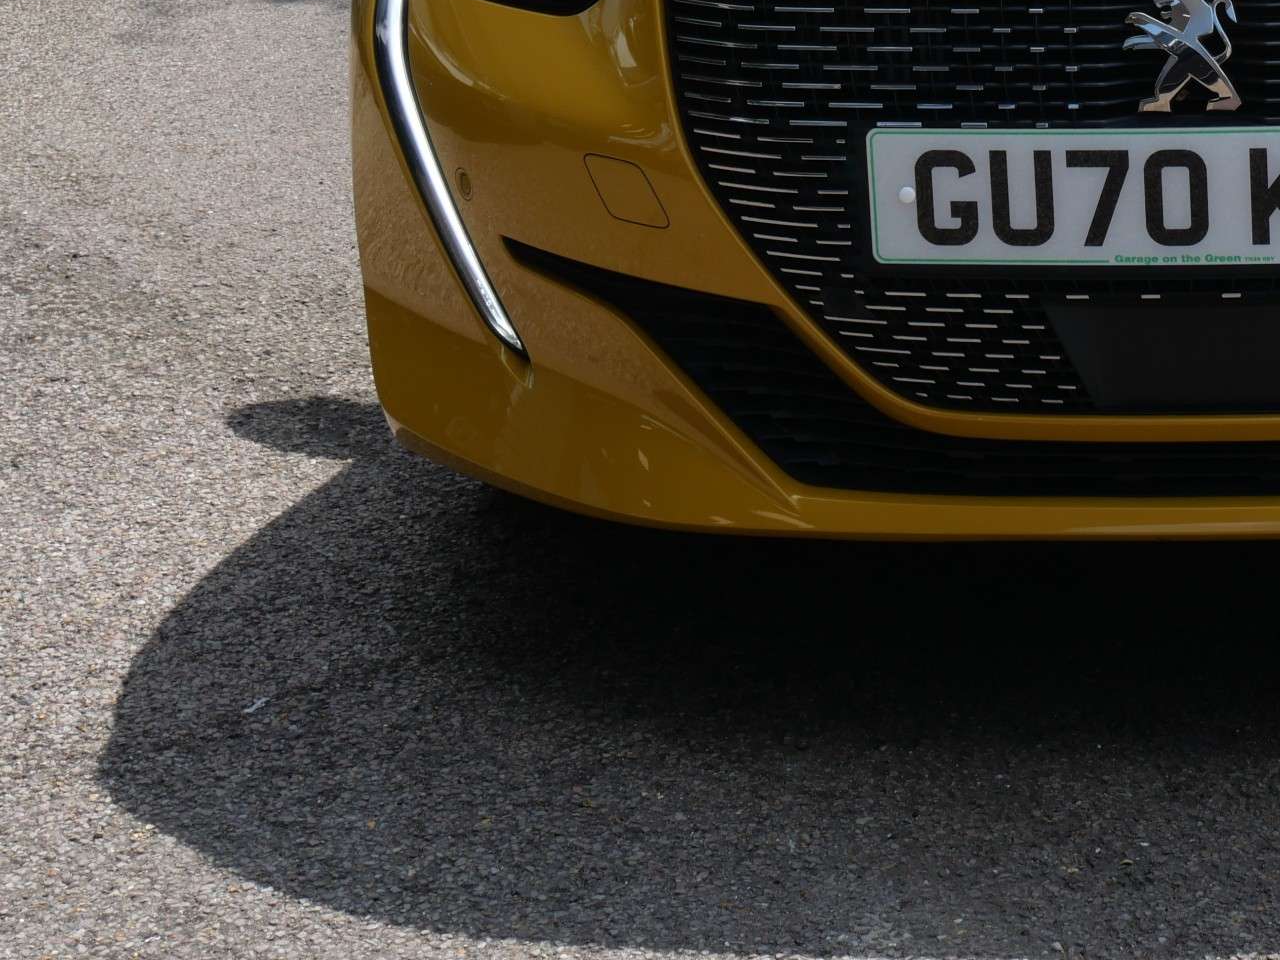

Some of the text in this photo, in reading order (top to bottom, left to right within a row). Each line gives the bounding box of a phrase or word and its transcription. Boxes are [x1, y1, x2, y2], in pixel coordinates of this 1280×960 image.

[914, 148, 1210, 247] GU70
[1114, 254, 1158, 265] Garage
[1162, 255, 1178, 264] on
[1181, 254, 1200, 264] the
[1204, 253, 1242, 263] Green
